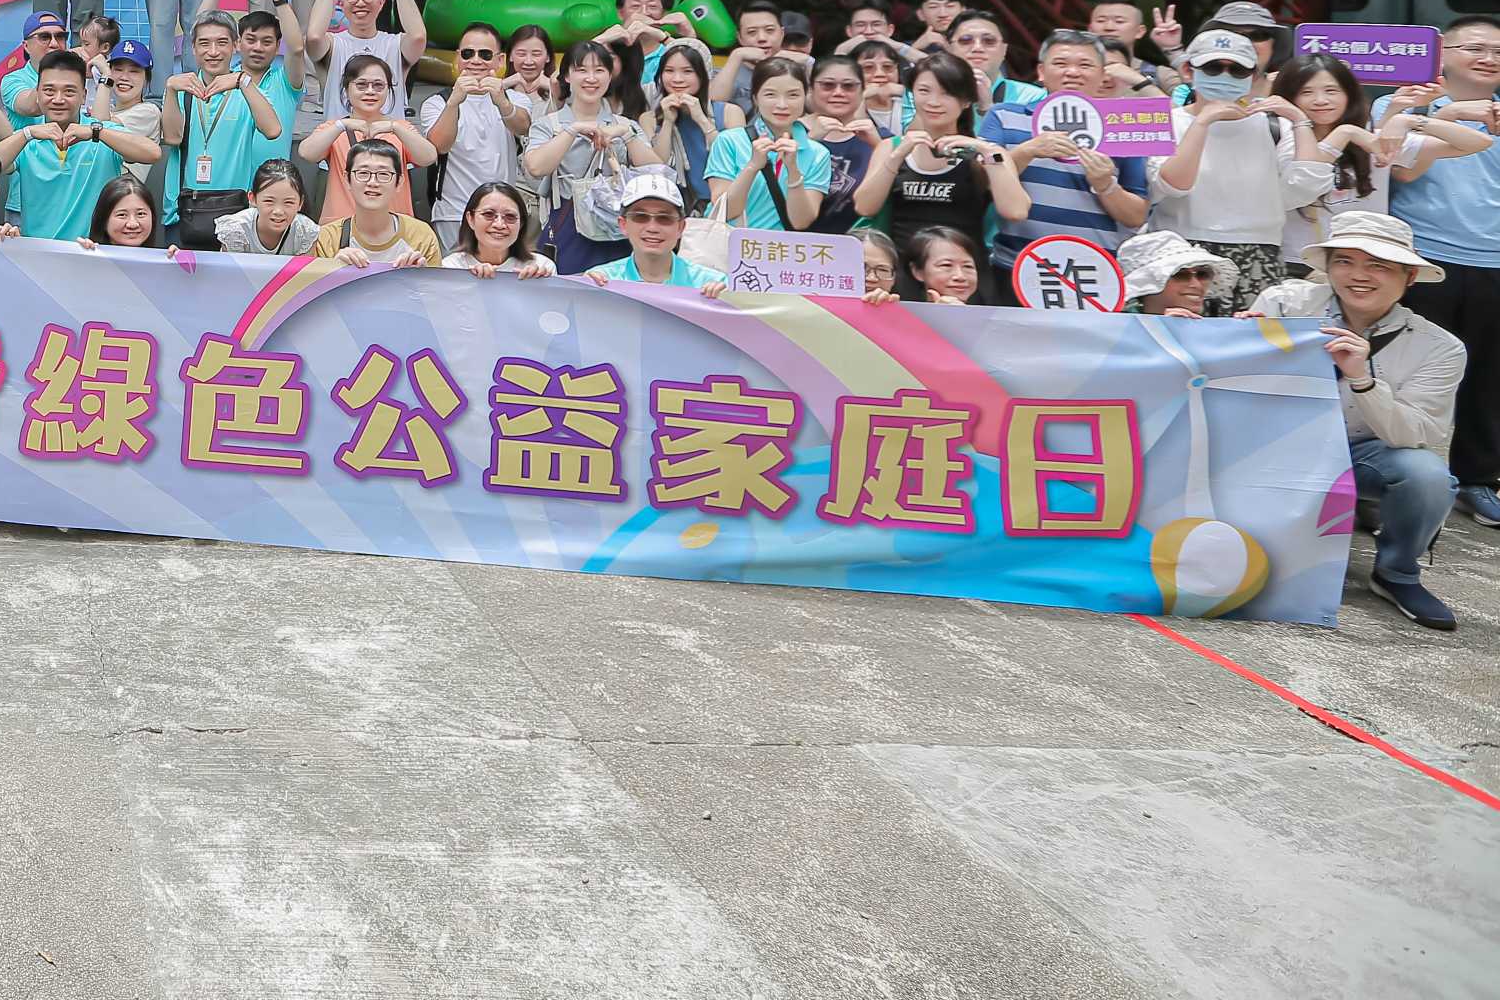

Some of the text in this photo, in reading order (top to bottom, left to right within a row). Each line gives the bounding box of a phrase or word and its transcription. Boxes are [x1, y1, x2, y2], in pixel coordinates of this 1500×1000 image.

[1301, 35, 1428, 56] 不給個人資料
[741, 239, 835, 265] 防詐5不
[780, 271, 855, 291] 做好防護
[1036, 258, 1099, 309] 詐
